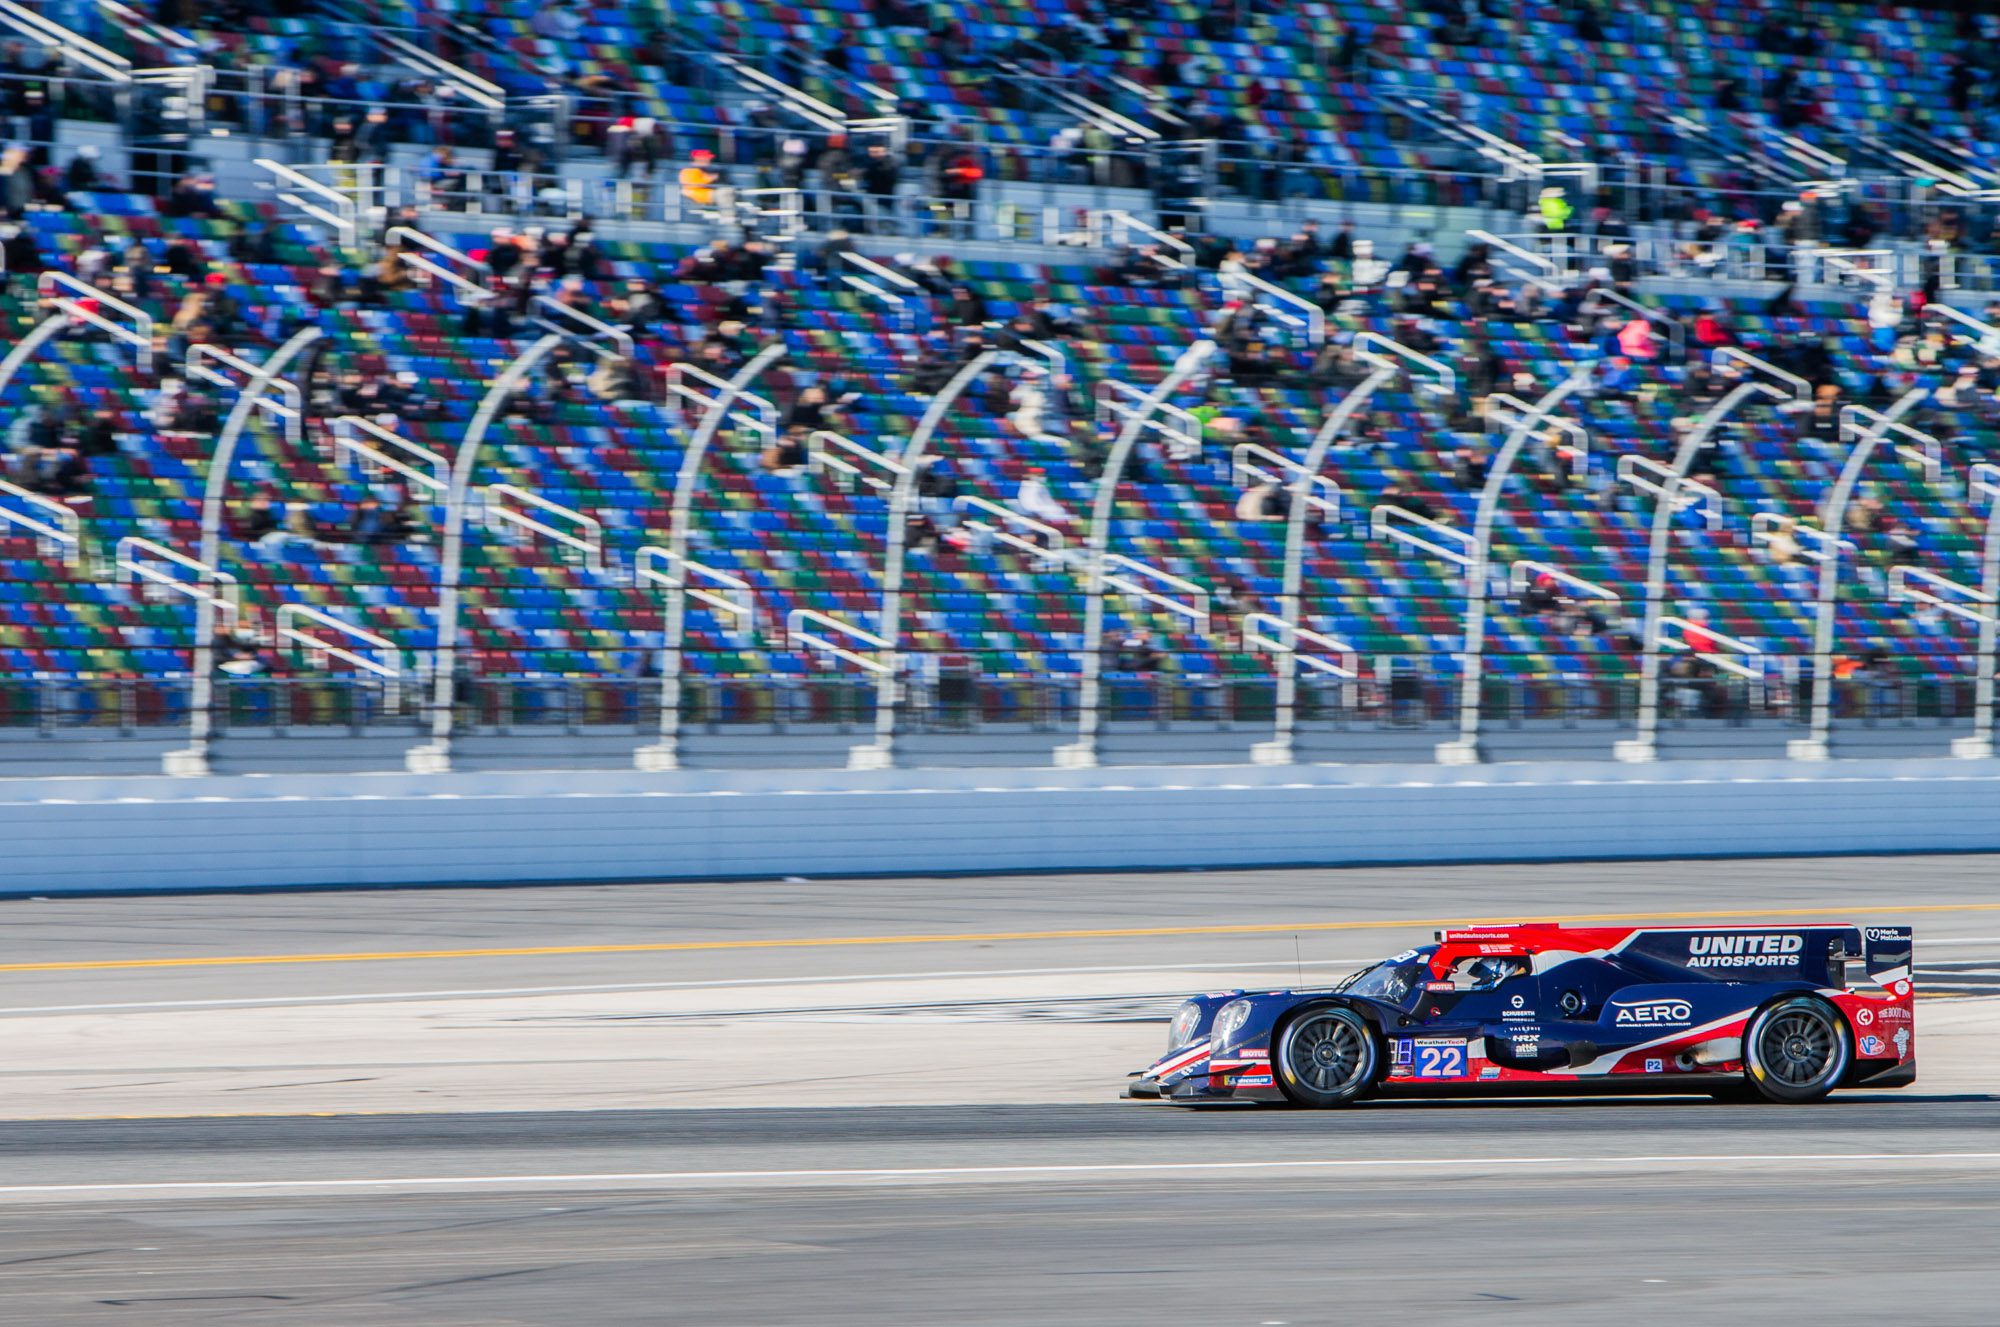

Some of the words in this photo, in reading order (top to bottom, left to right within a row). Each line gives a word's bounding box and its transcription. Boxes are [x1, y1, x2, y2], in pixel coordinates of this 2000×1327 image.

[1689, 935, 1803, 955] UNITED
[1686, 955, 1800, 967] AUTOSPORTS
[1429, 982, 1454, 990] MOTUL
[1616, 1005, 1691, 1022] AERO
[1421, 1047, 1462, 1076] 22
[1647, 1060, 1661, 1070] P2
